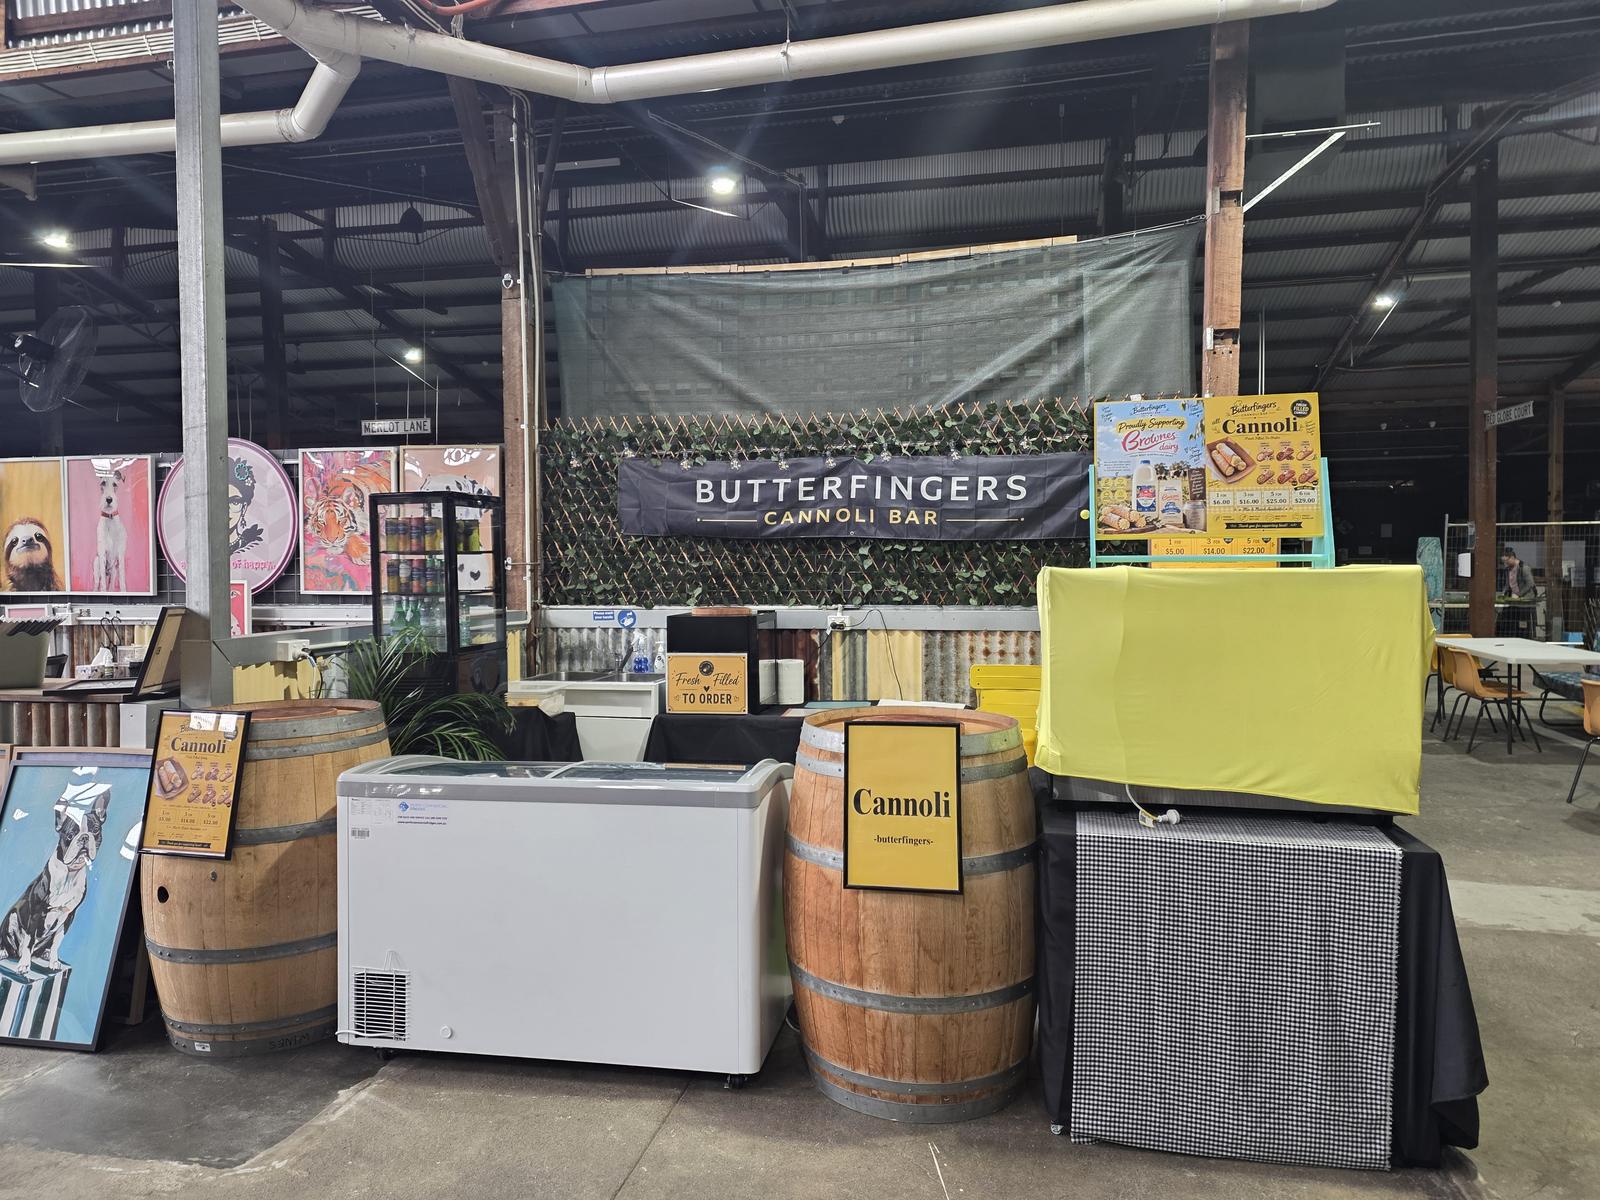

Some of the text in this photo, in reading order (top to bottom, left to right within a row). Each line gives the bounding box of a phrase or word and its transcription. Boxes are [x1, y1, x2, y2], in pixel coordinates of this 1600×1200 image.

[1231, 402, 1276, 416] Butterfingers
[1514, 404, 1531, 418] COURT
[364, 420, 429, 434] MERLOT LANE
[1118, 418, 1186, 434] Proudly Supporting
[1222, 417, 1298, 434] Cannoli
[1122, 430, 1176, 452] Brownes
[1158, 443, 1179, 453] dairy
[696, 474, 1027, 504] BUTTERFINGERS
[764, 508, 938, 526] CANNOLI BAR
[676, 672, 739, 687] Fresh Filled
[682, 693, 732, 704] TO ORDER
[170, 737, 226, 754] Cannoli
[853, 788, 951, 818] Cannoli
